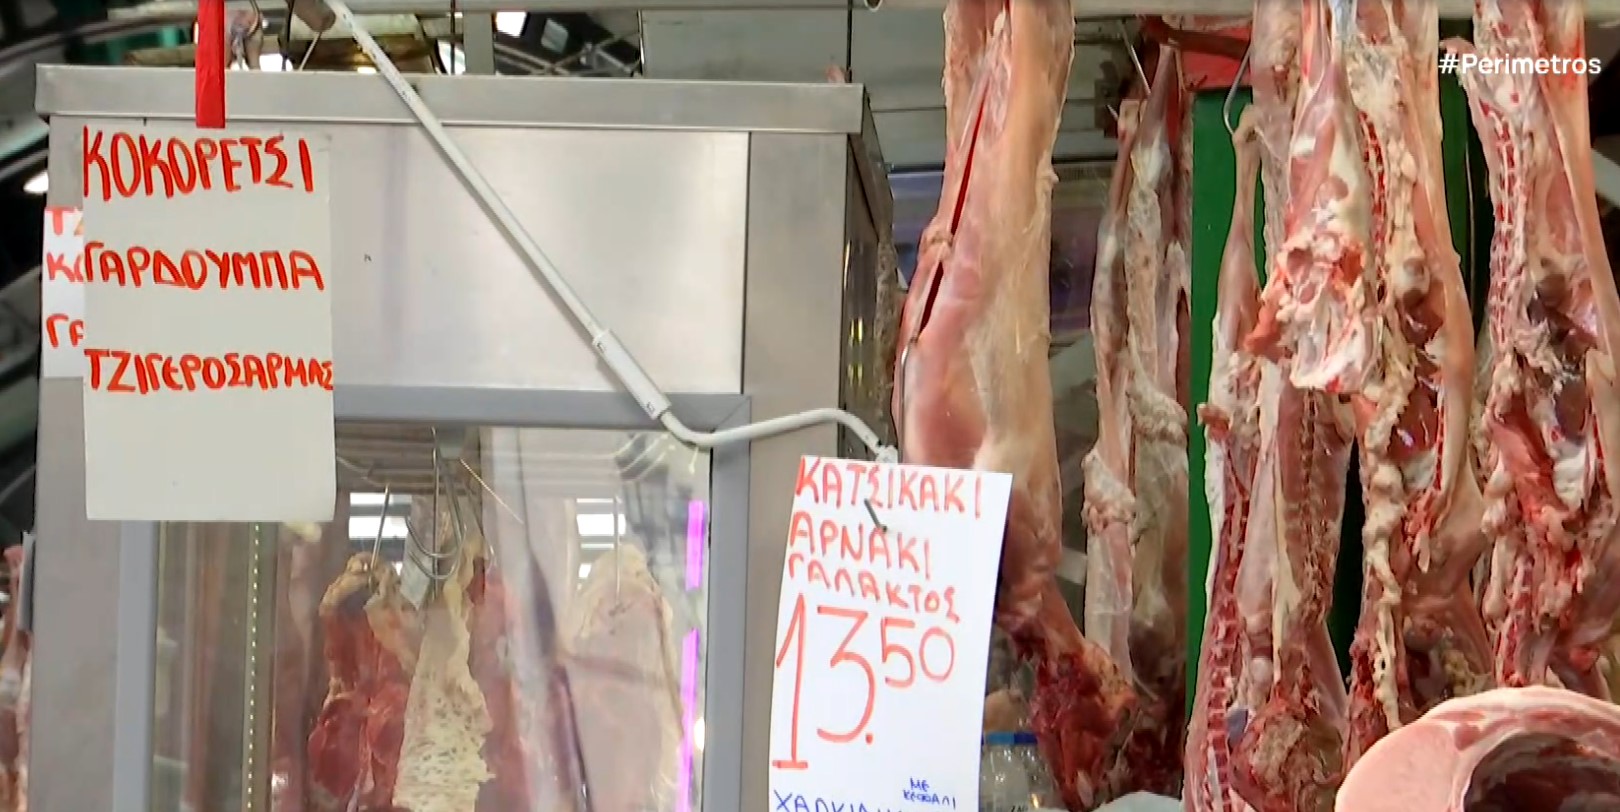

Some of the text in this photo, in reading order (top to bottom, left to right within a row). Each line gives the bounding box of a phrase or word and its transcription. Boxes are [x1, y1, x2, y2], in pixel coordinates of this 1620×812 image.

[82, 125, 313, 201] ΚΟΚΟΡΕΤΣΙ
[84, 241, 324, 290] ΓΑΡΔΟΥΜΠΑ
[795, 456, 981, 519] ΚΑΤΣΙΚΑΚΙ
[789, 510, 930, 580] ΑΡΝΑΚΙ
[788, 553, 960, 623] ΓΑΛΑΚΤΟΣ
[909, 777, 930, 792] ΜΕ
